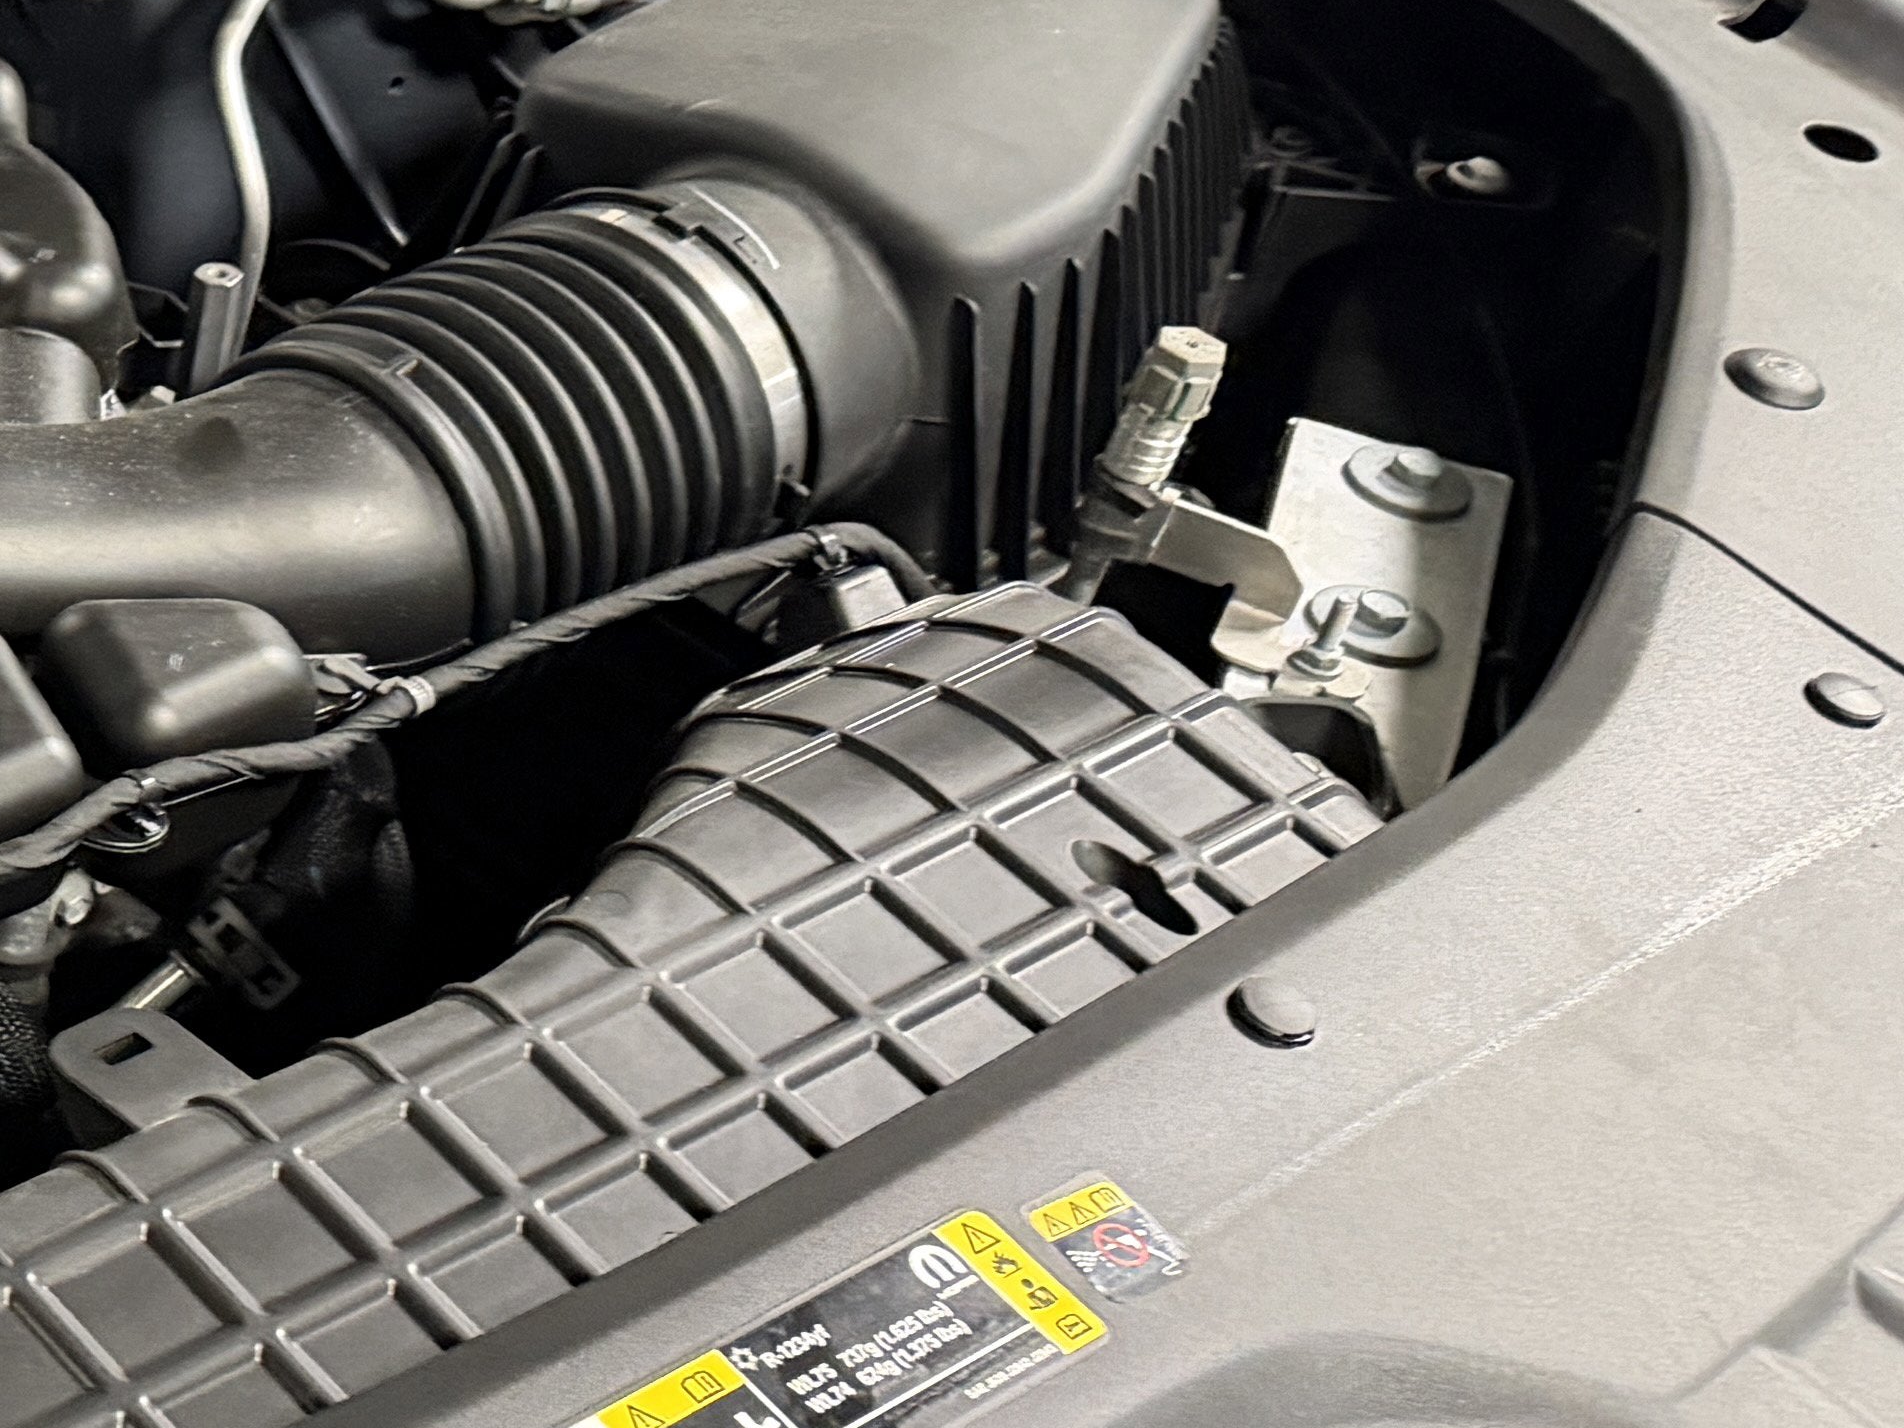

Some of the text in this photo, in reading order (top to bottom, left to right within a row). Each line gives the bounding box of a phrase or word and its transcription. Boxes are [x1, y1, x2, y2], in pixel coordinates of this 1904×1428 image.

[759, 1323, 832, 1369] R-1234yf
[786, 1300, 955, 1396] WL75 737g (1.625 lbs)
[804, 1318, 974, 1414] WL74 624g (1.375 lbs)
